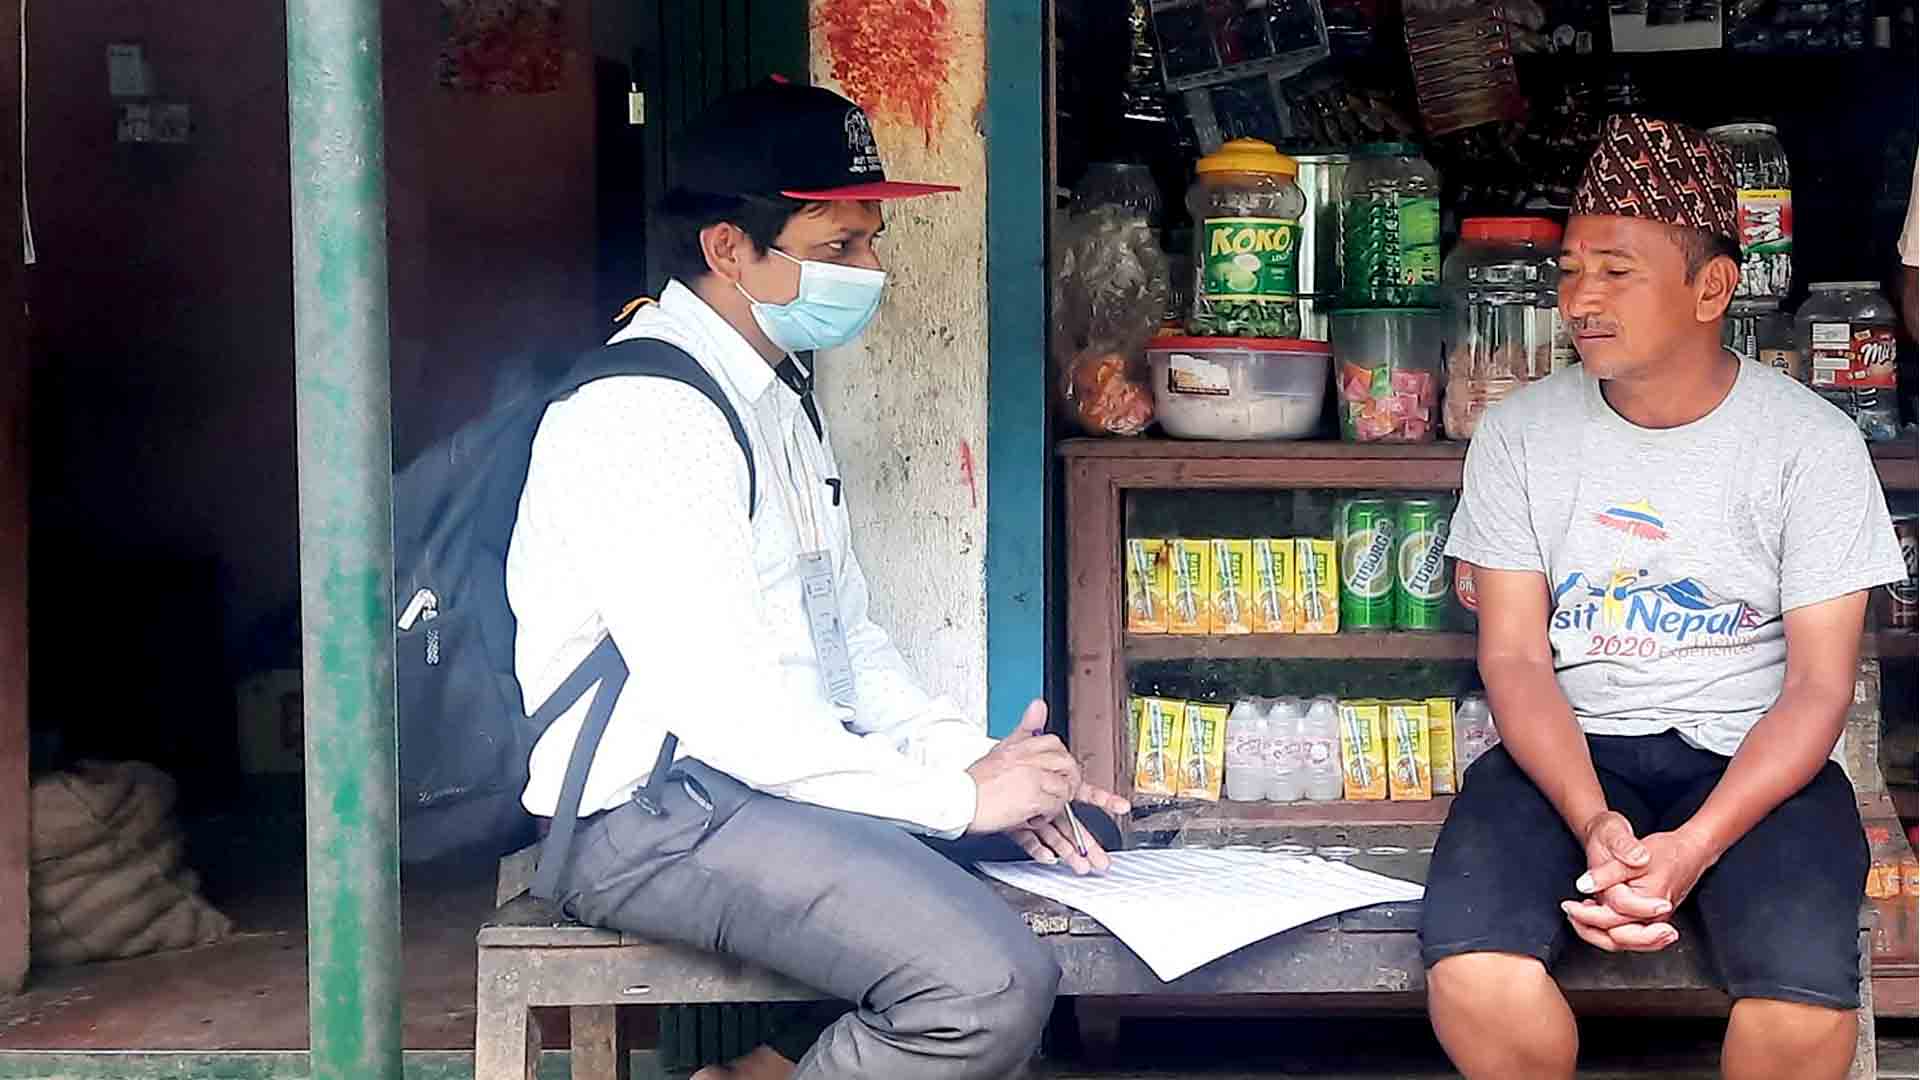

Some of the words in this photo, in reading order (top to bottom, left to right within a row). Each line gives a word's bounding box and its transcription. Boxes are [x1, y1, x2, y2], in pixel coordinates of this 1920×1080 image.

[1211, 226, 1291, 257] KOKO
[1351, 535, 1390, 589] TUBORG
[1408, 536, 1446, 592] TUBORG
[1554, 603, 1599, 630] sit
[1625, 594, 1743, 641] Nepal
[1586, 633, 1657, 657] 2020
